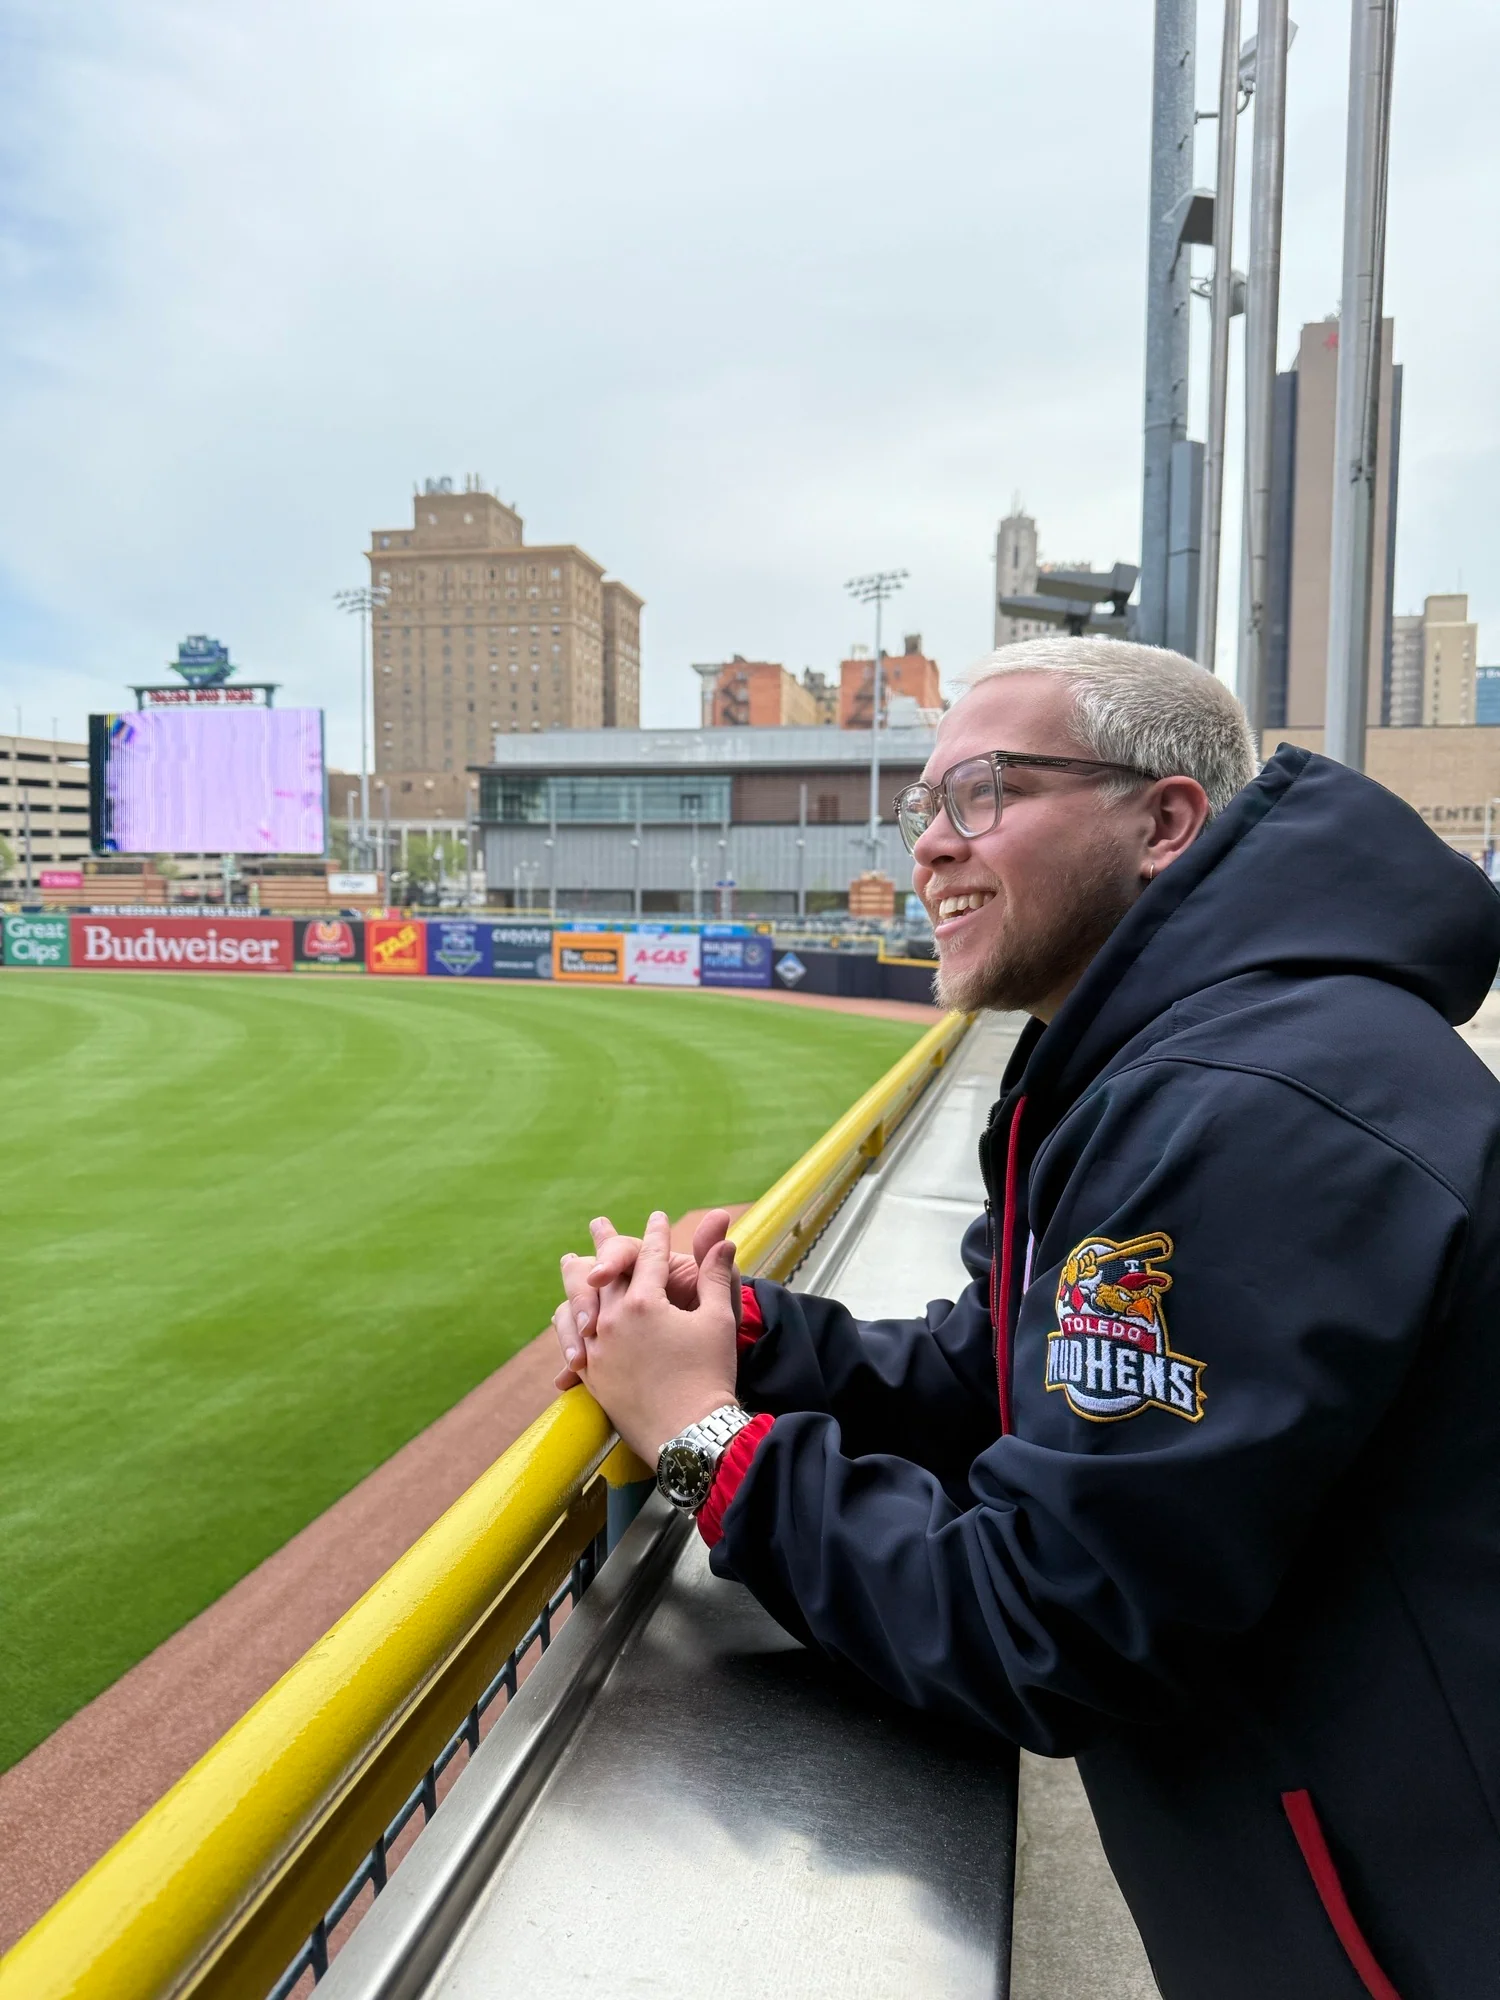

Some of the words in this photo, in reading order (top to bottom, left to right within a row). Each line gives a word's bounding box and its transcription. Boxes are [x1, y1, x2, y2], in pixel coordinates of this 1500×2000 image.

[6, 918, 66, 939] Great
[11, 938, 61, 964] Clips
[82, 925, 280, 964] Budweiser
[1124, 1259, 1140, 1273] T
[1064, 1317, 1141, 1341] TOLEDO
